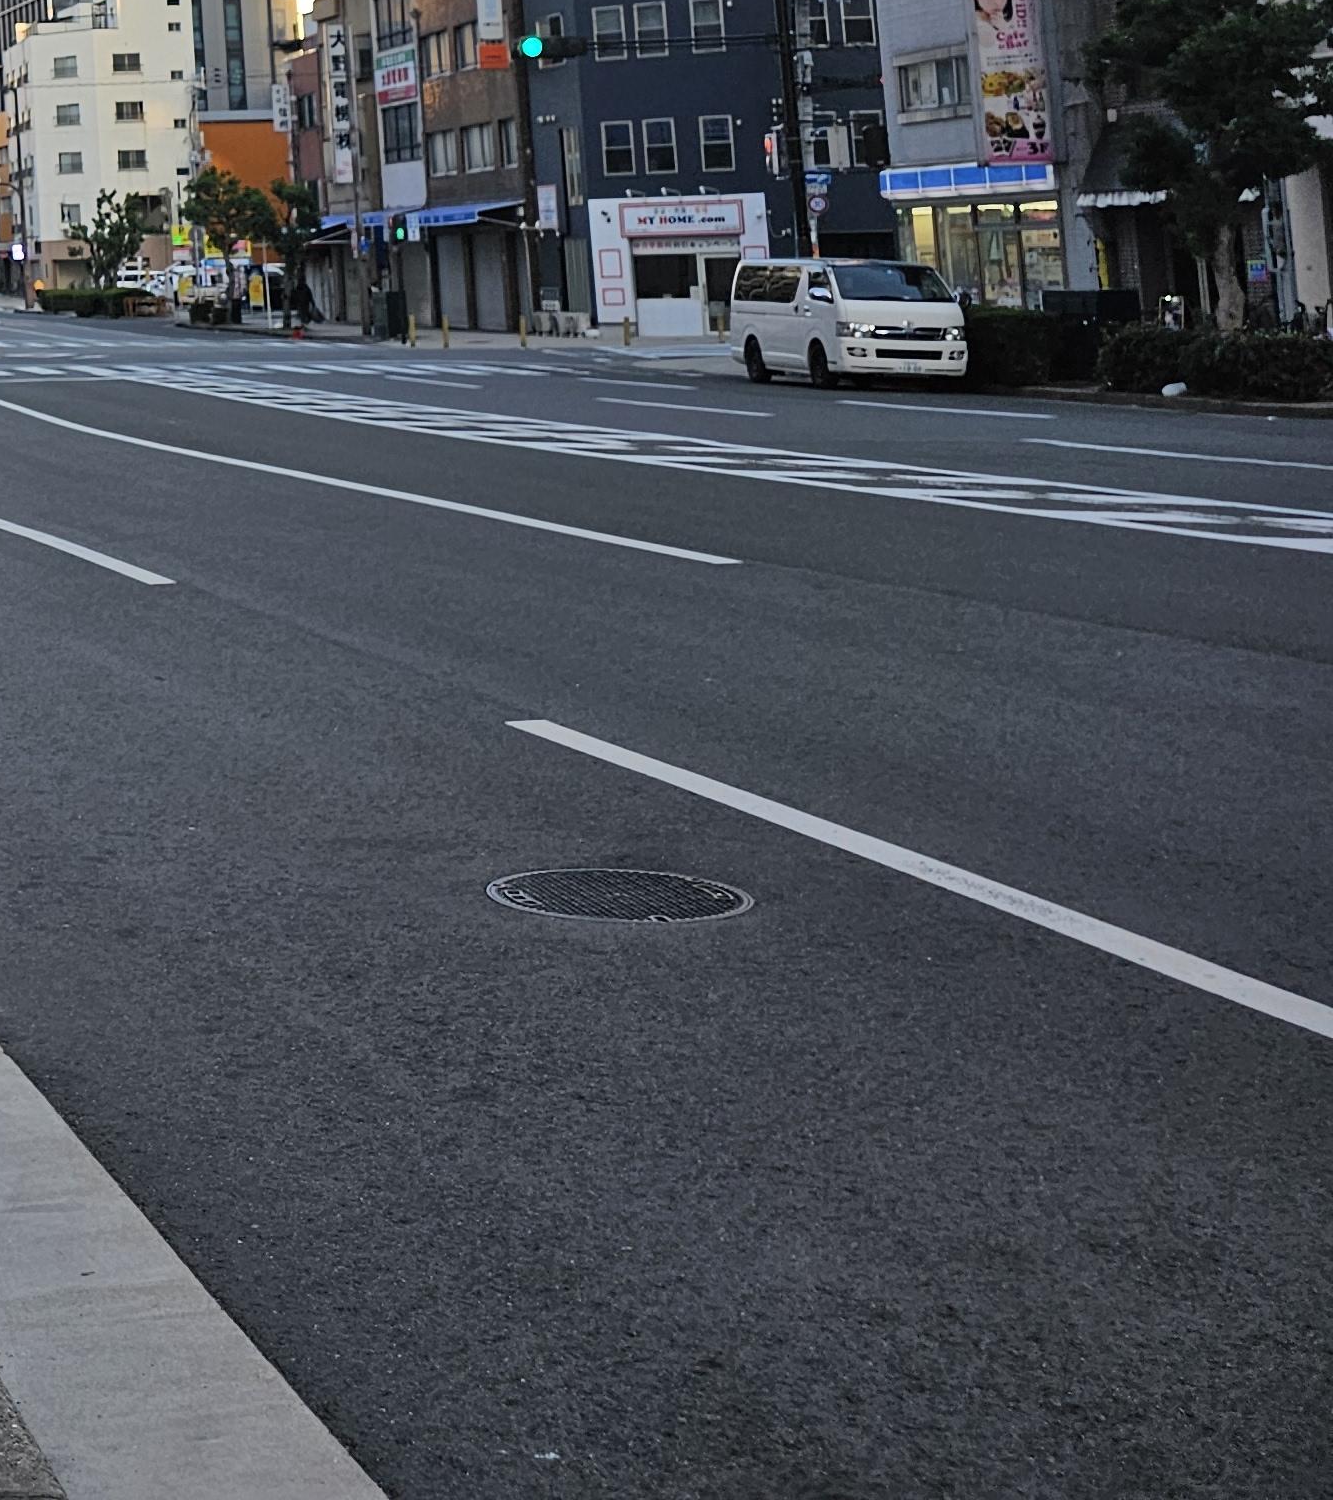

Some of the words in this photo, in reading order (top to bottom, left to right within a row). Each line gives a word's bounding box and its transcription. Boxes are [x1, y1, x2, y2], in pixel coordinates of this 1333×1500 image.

[637, 215, 655, 225] MY
[659, 214, 695, 225] HOME
[698, 215, 726, 224] .com
